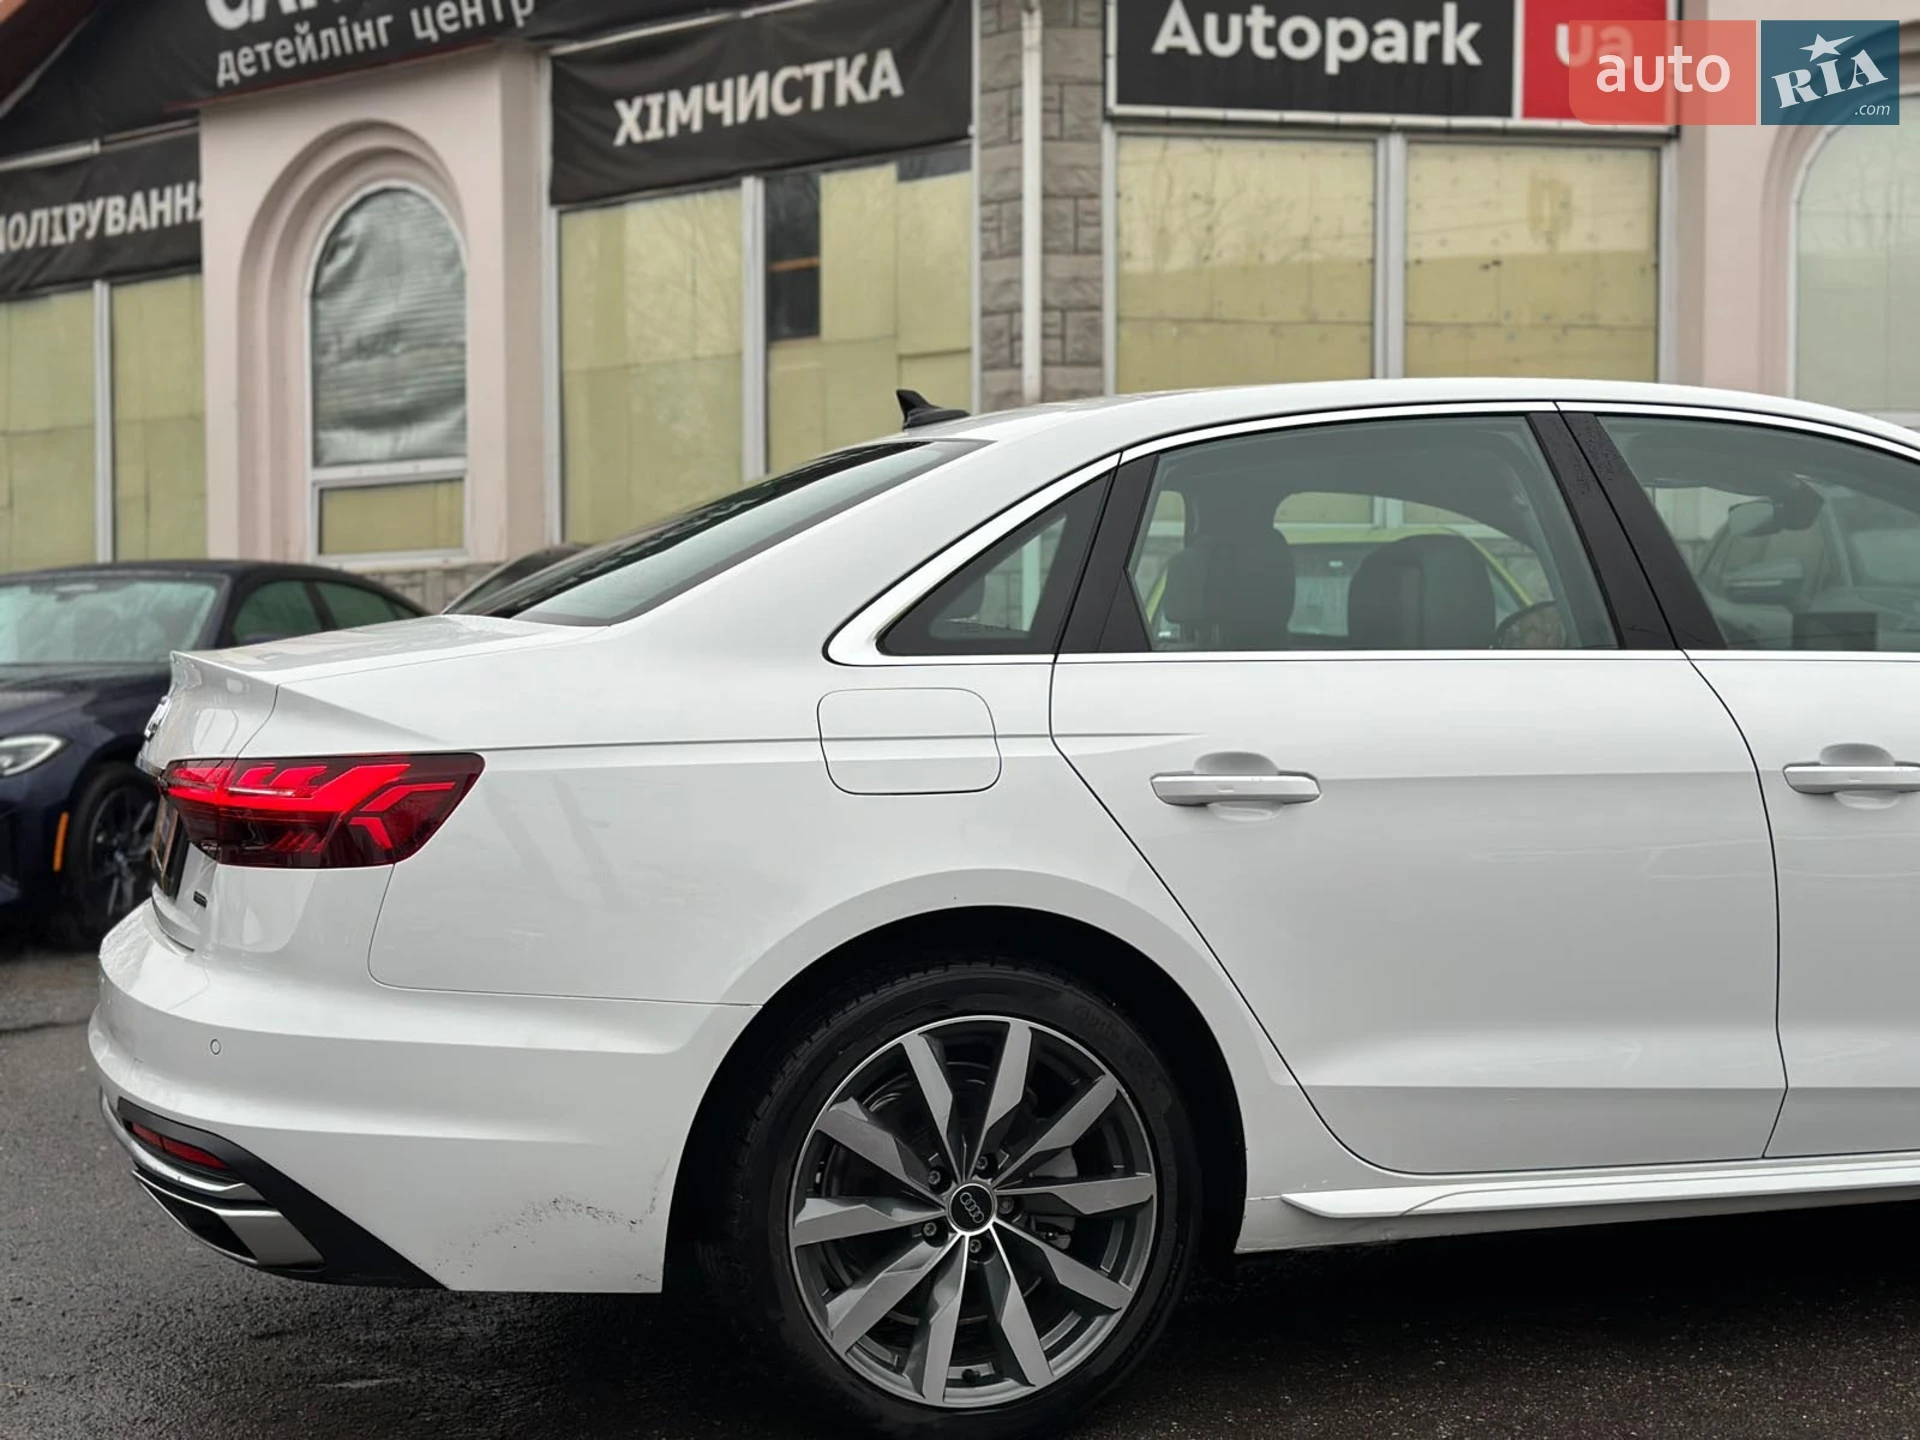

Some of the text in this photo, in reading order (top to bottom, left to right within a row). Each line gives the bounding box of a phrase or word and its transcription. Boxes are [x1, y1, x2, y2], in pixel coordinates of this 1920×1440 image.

[217, 15, 393, 88] детейлінг
[1151, 0, 1482, 75] Autopark
[613, 48, 904, 147] ХІМЧИСТКА
